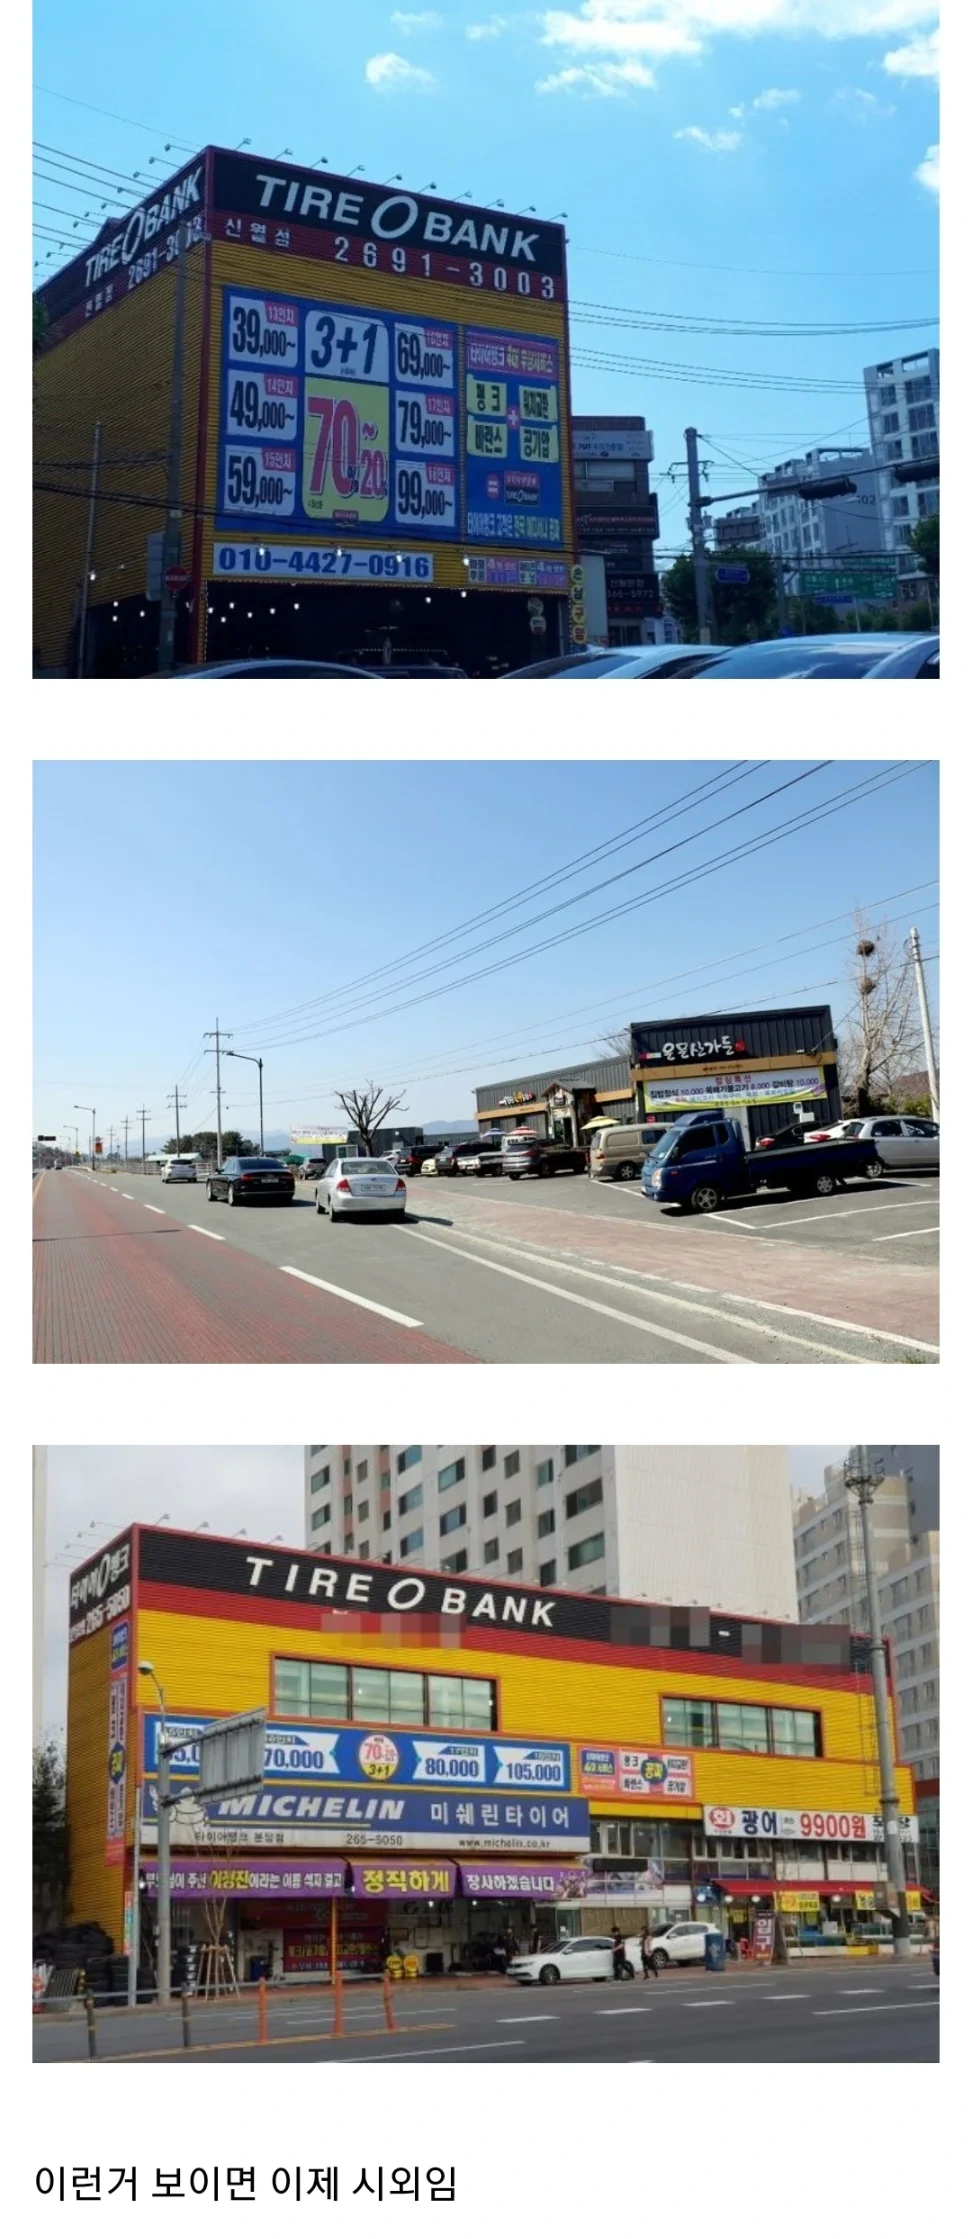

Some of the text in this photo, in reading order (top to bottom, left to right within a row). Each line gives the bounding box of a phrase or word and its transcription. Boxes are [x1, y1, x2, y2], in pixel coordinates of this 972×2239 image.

[85, 232, 124, 287] TIRE
[144, 166, 202, 242] BANK
[255, 174, 363, 226] TIRE
[423, 212, 540, 262] BANK
[334, 236, 555, 299] 2691-3003
[311, 316, 378, 374] 3+1
[219, 547, 429, 578] 010-4427-0916
[246, 1556, 373, 1603] TIRE
[441, 1587, 557, 1628] BANK
[368, 1763, 390, 1776] 3+1
[425, 1757, 479, 1778] 80,000
[506, 1763, 561, 1782] 105,000
[218, 1794, 405, 1820] MICHELIN
[430, 1802, 569, 1829] 미쉐린타이어
[741, 1811, 778, 1836] 광어
[800, 1813, 867, 1839] 9900원
[346, 1833, 403, 1846] 265-5050
[459, 1837, 551, 1848] www.michelin.co.kr
[363, 1869, 450, 1893] 정직하게
[466, 1874, 555, 1891] 장사하겠습니다
[757, 1918, 773, 1951] 입구
